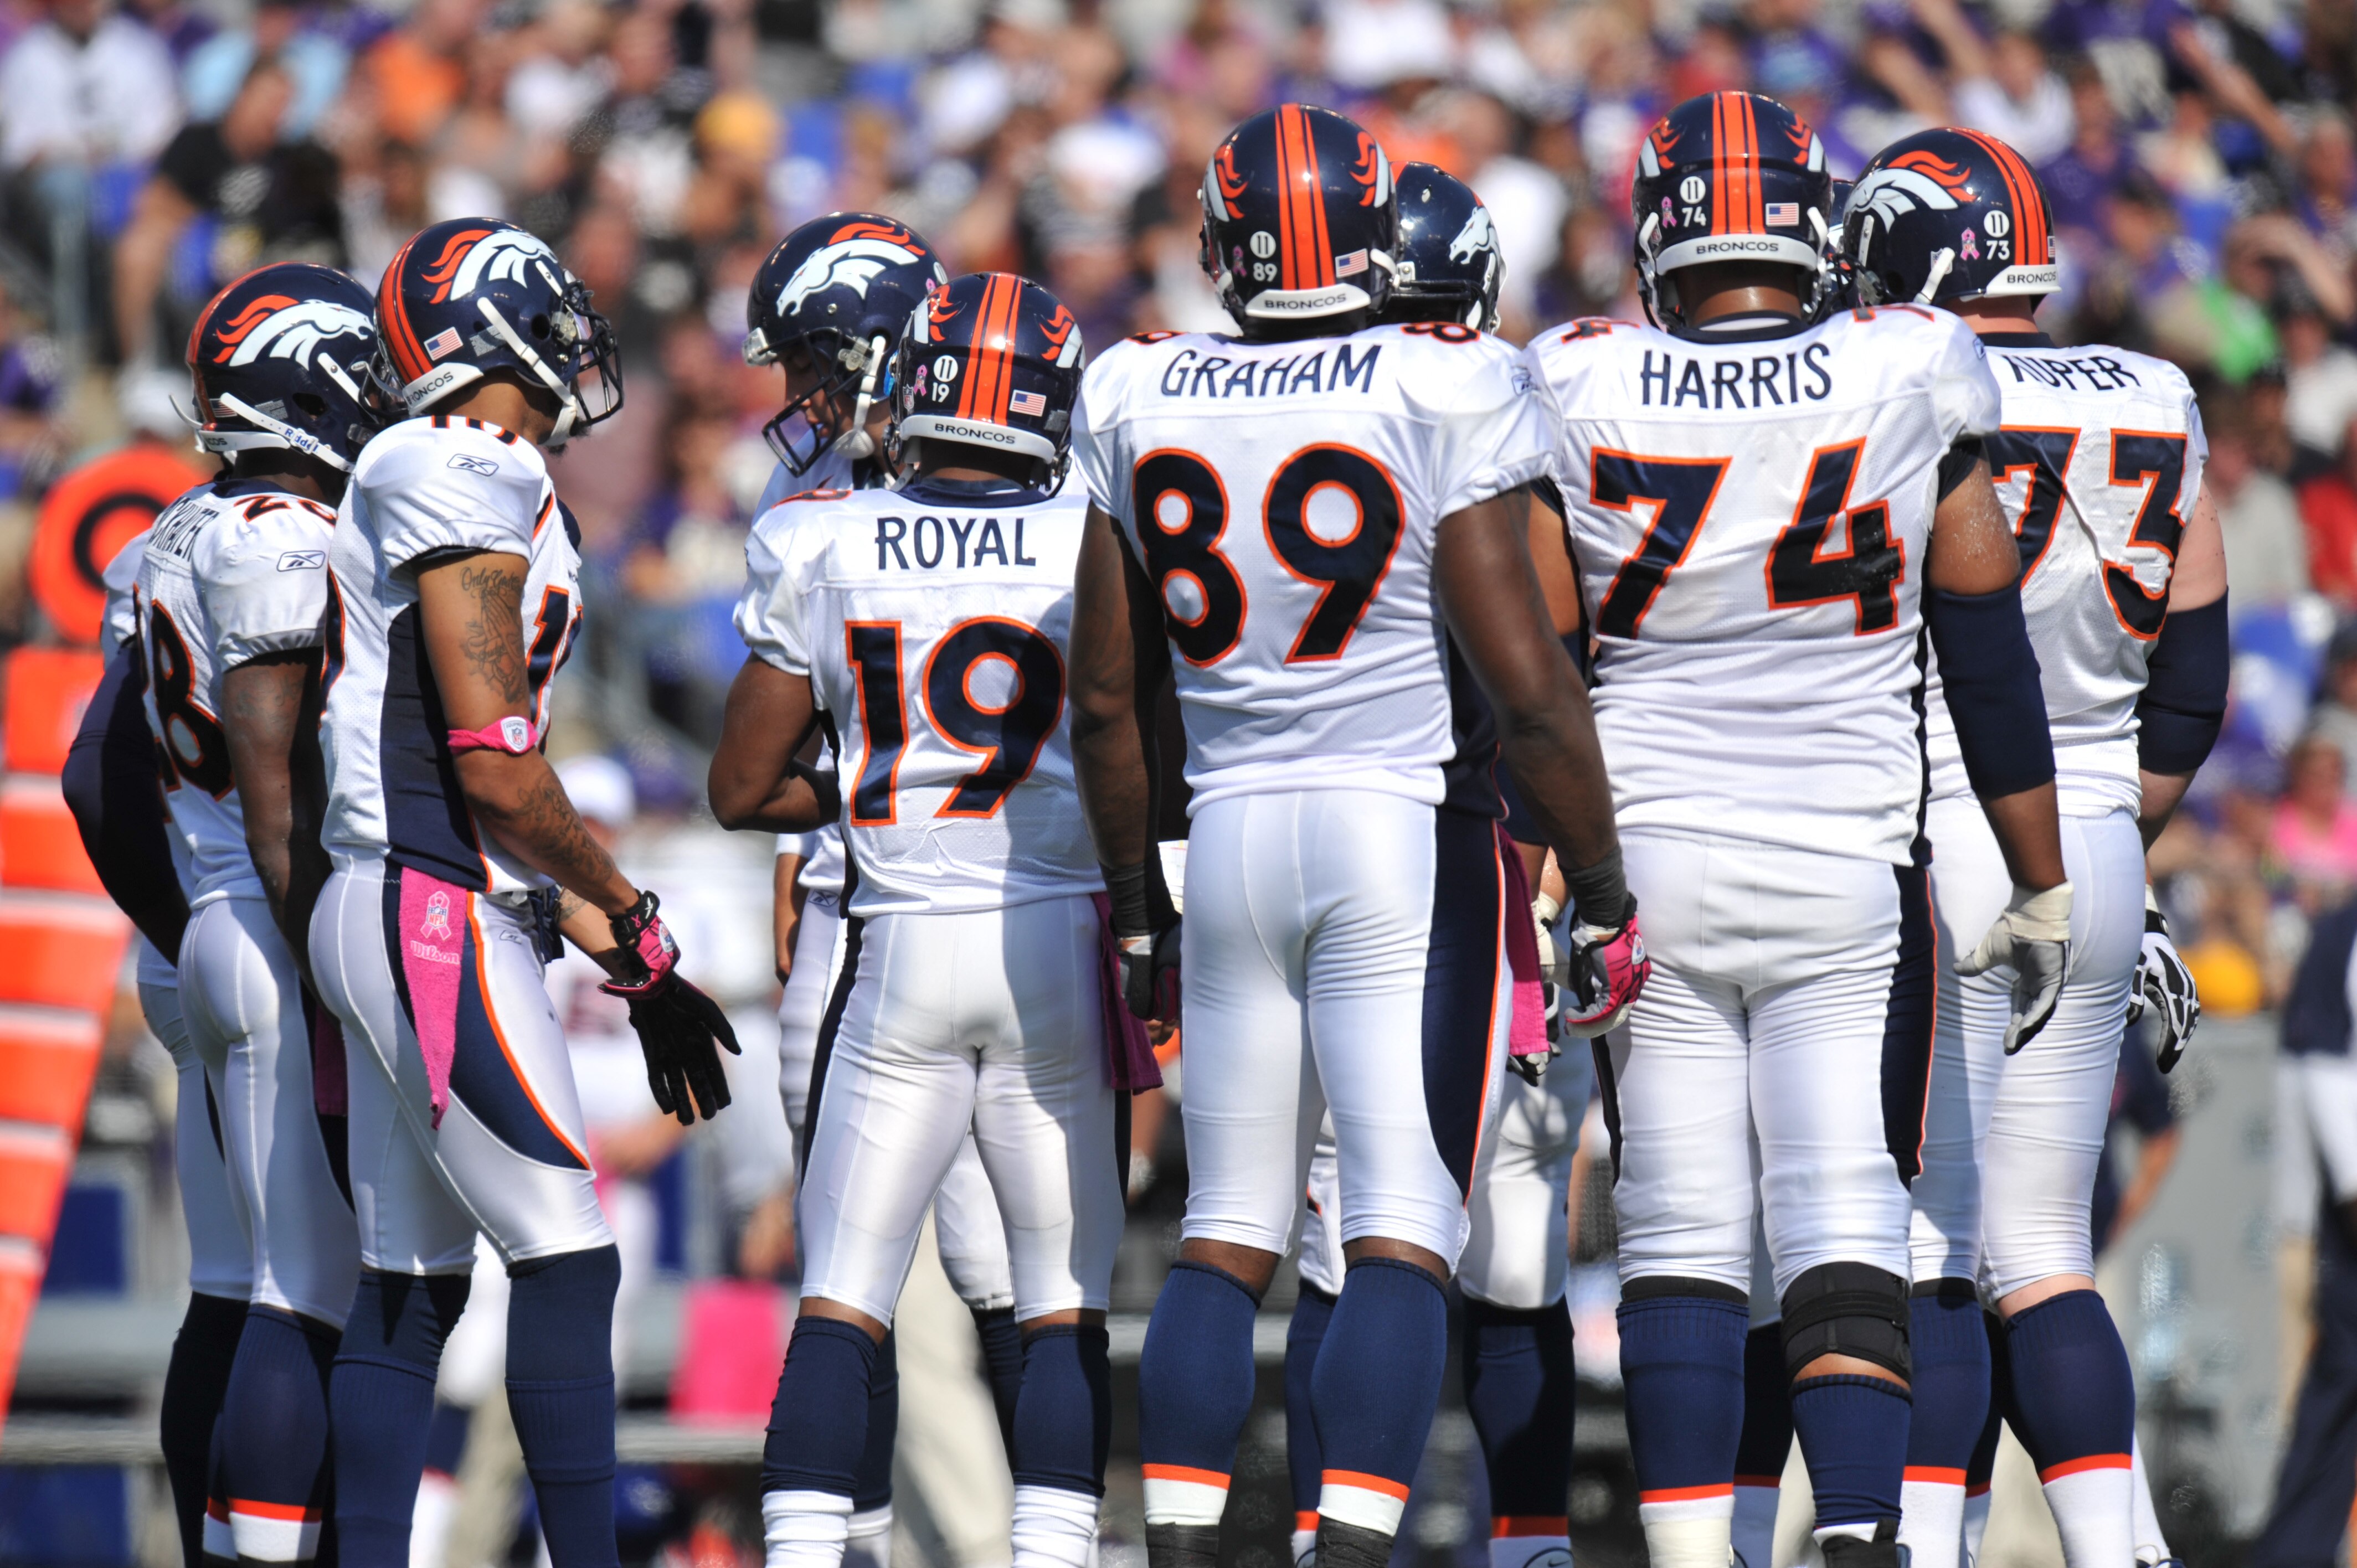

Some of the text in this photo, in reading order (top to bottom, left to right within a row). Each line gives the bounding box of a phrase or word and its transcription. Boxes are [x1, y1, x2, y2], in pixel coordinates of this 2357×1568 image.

[1687, 179, 1699, 199] 11
[1682, 206, 1707, 228] 74
[1991, 214, 2003, 233] 11
[1257, 235, 1268, 255] 11
[1696, 241, 1779, 254] BRONCOS
[1986, 240, 2010, 260] 73
[1253, 262, 1278, 282] 89
[2007, 271, 2056, 283] BRONCOS
[1265, 293, 1346, 309] BRONCOS
[939, 358, 953, 379] 11
[1161, 344, 1383, 398] GRAHAM
[1640, 342, 1832, 410] HARRIS
[2001, 353, 2142, 391] KUPER
[406, 372, 454, 405] BRONCOS
[932, 382, 950, 403] 19
[935, 423, 1016, 444] BRONCOS
[874, 515, 1036, 570] ROYAL
[1590, 436, 1906, 640] 74
[1992, 425, 2188, 641] 73
[1131, 441, 1406, 669] 89
[845, 615, 1066, 827] 19
[429, 914, 445, 925] NFL
[410, 940, 461, 964] Wilson
